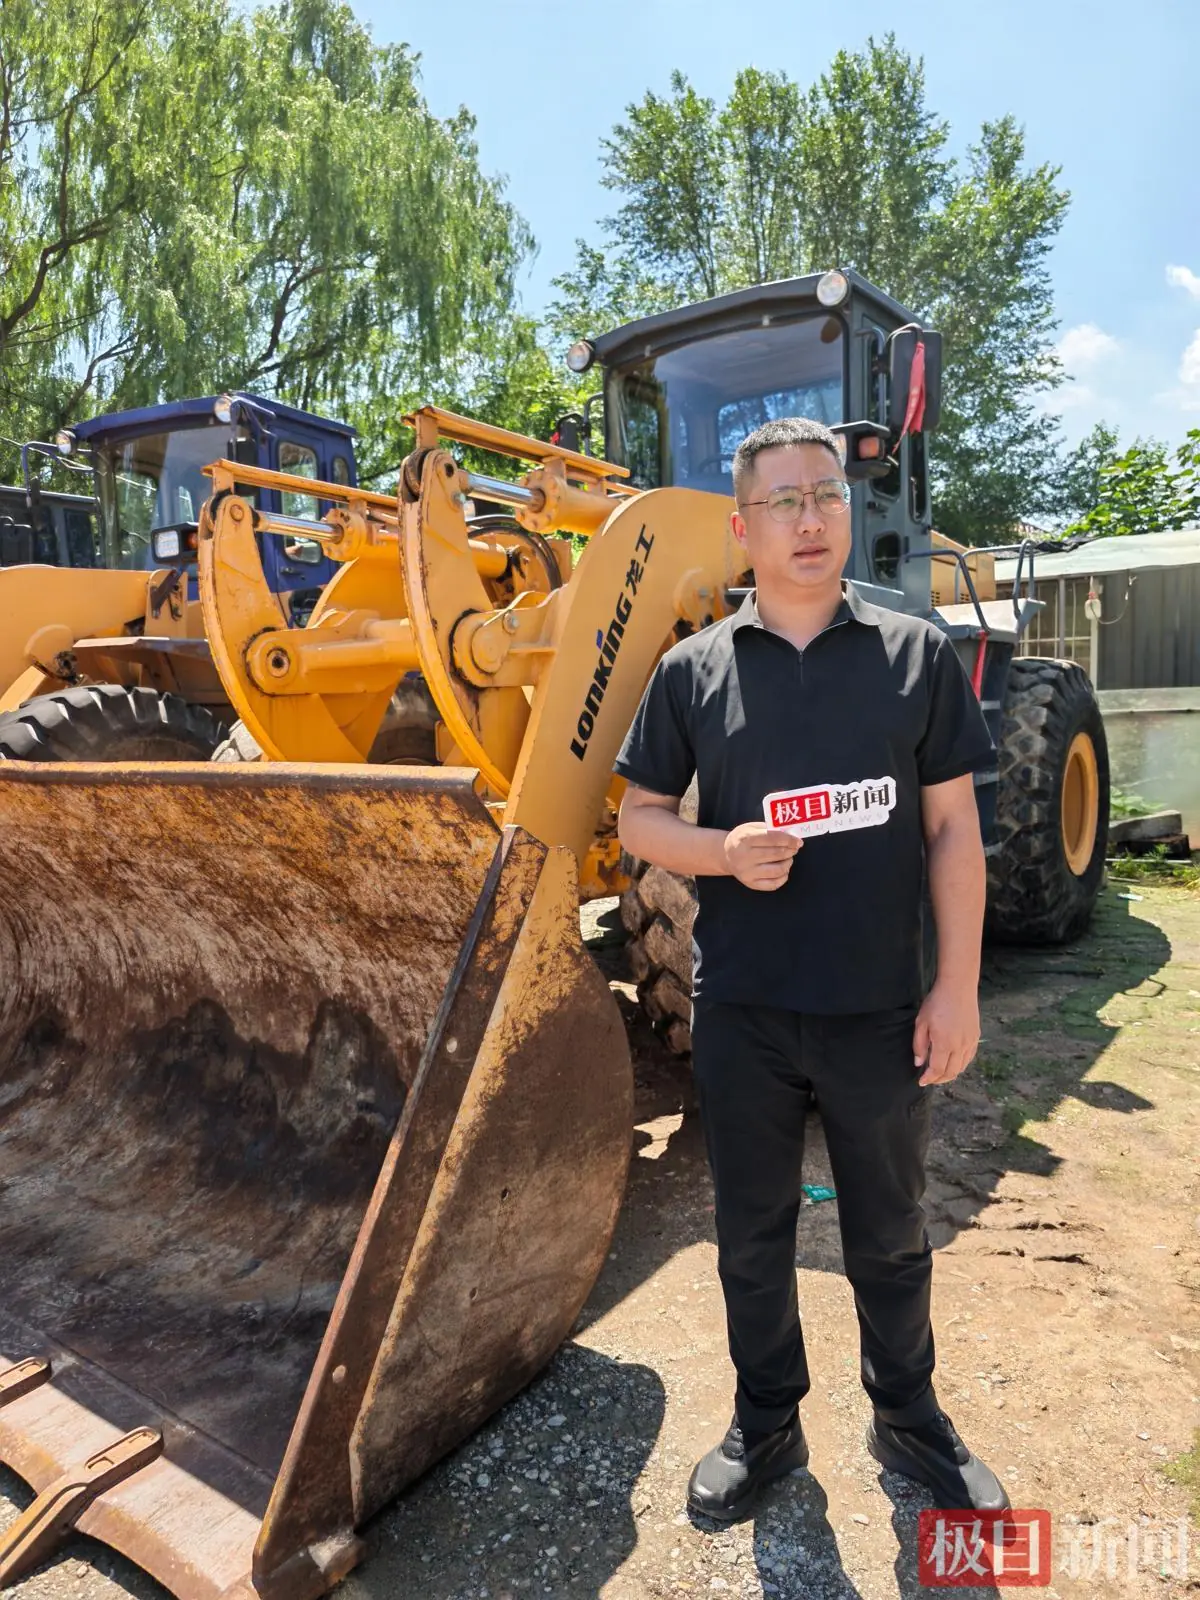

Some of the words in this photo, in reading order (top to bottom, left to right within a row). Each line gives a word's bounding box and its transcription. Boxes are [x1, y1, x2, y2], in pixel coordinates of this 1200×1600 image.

[625, 523, 655, 597] 龙工
[774, 783, 890, 824] 极目新闻
